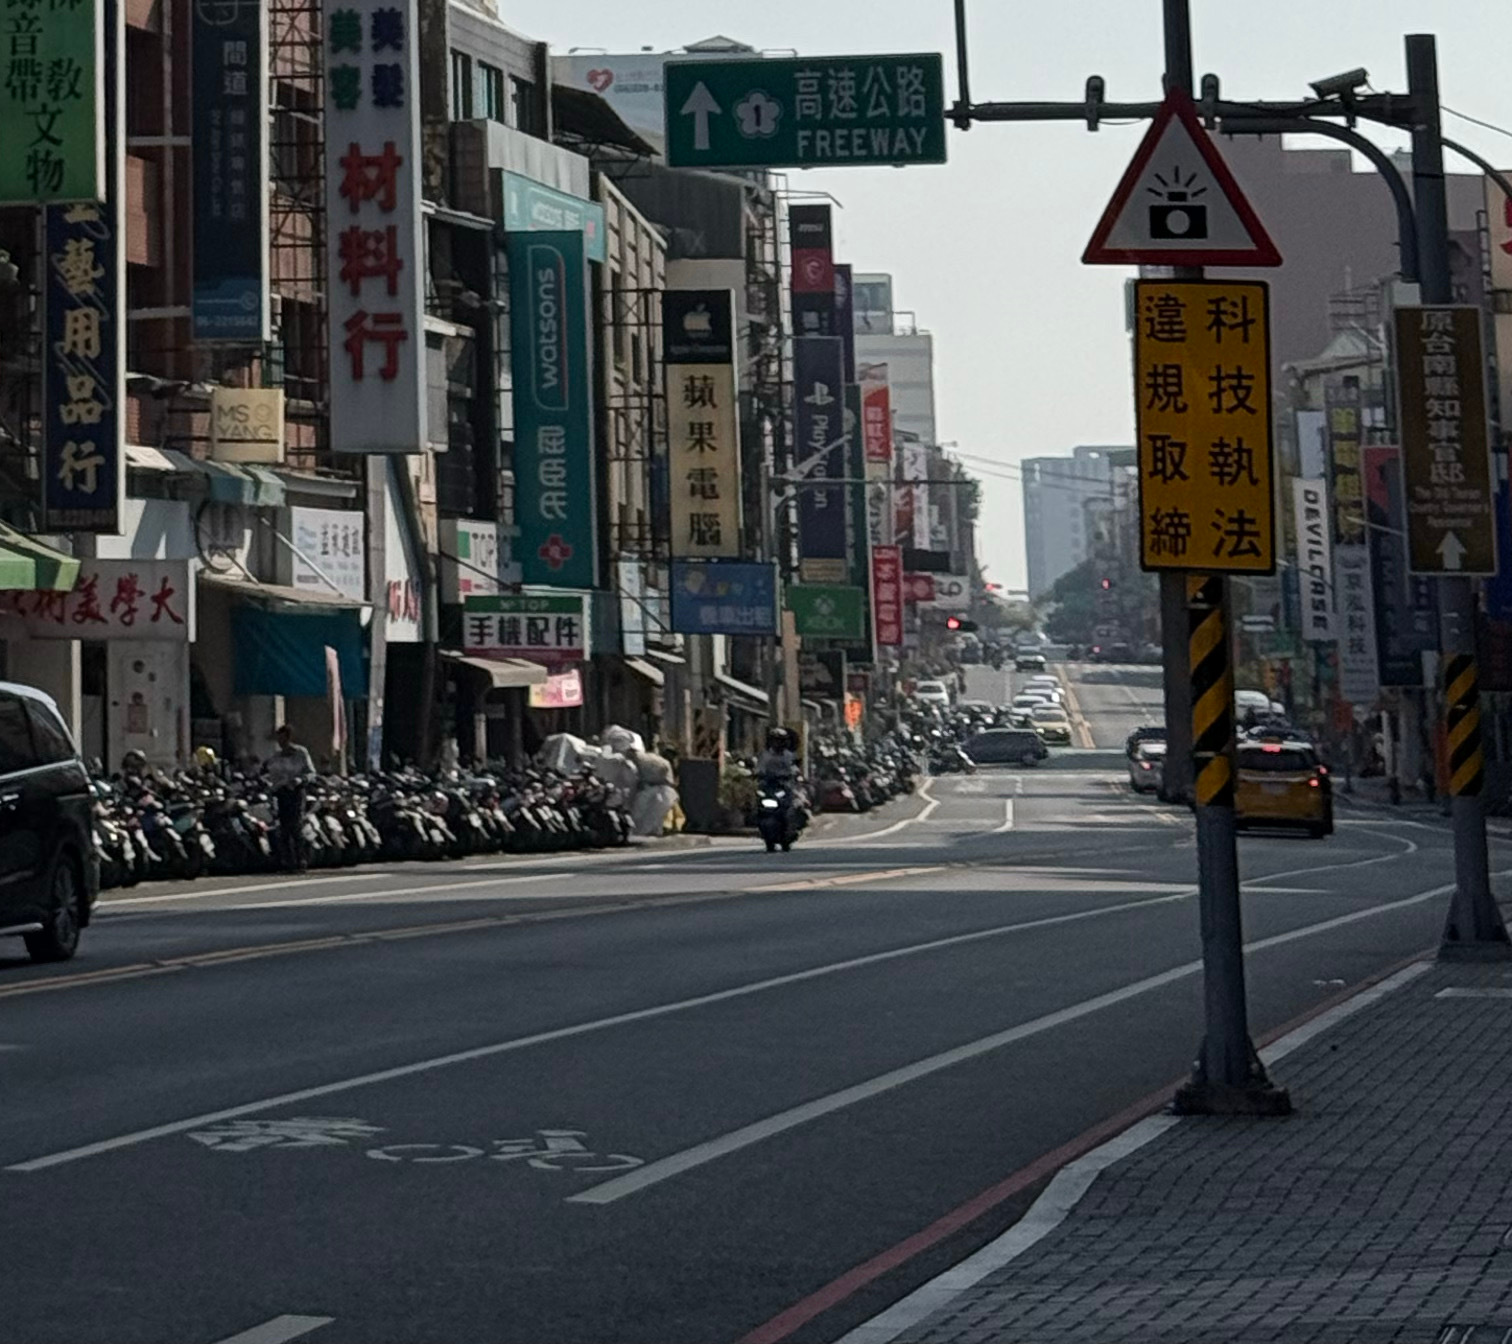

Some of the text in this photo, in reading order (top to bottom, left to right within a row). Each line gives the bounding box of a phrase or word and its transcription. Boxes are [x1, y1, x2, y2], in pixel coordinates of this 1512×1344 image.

[793, 64, 928, 121] 高速公路
[796, 126, 929, 158] FREEWAY
[338, 140, 408, 381] 材料行
[536, 267, 559, 389] watsons
[683, 374, 723, 547] 蘋果電腦
[1144, 293, 1191, 559] 違規取締
[1207, 293, 1263, 560] 科技執法
[469, 615, 578, 646] 手機配件
[1302, 488, 1329, 632] DEVILCASE
